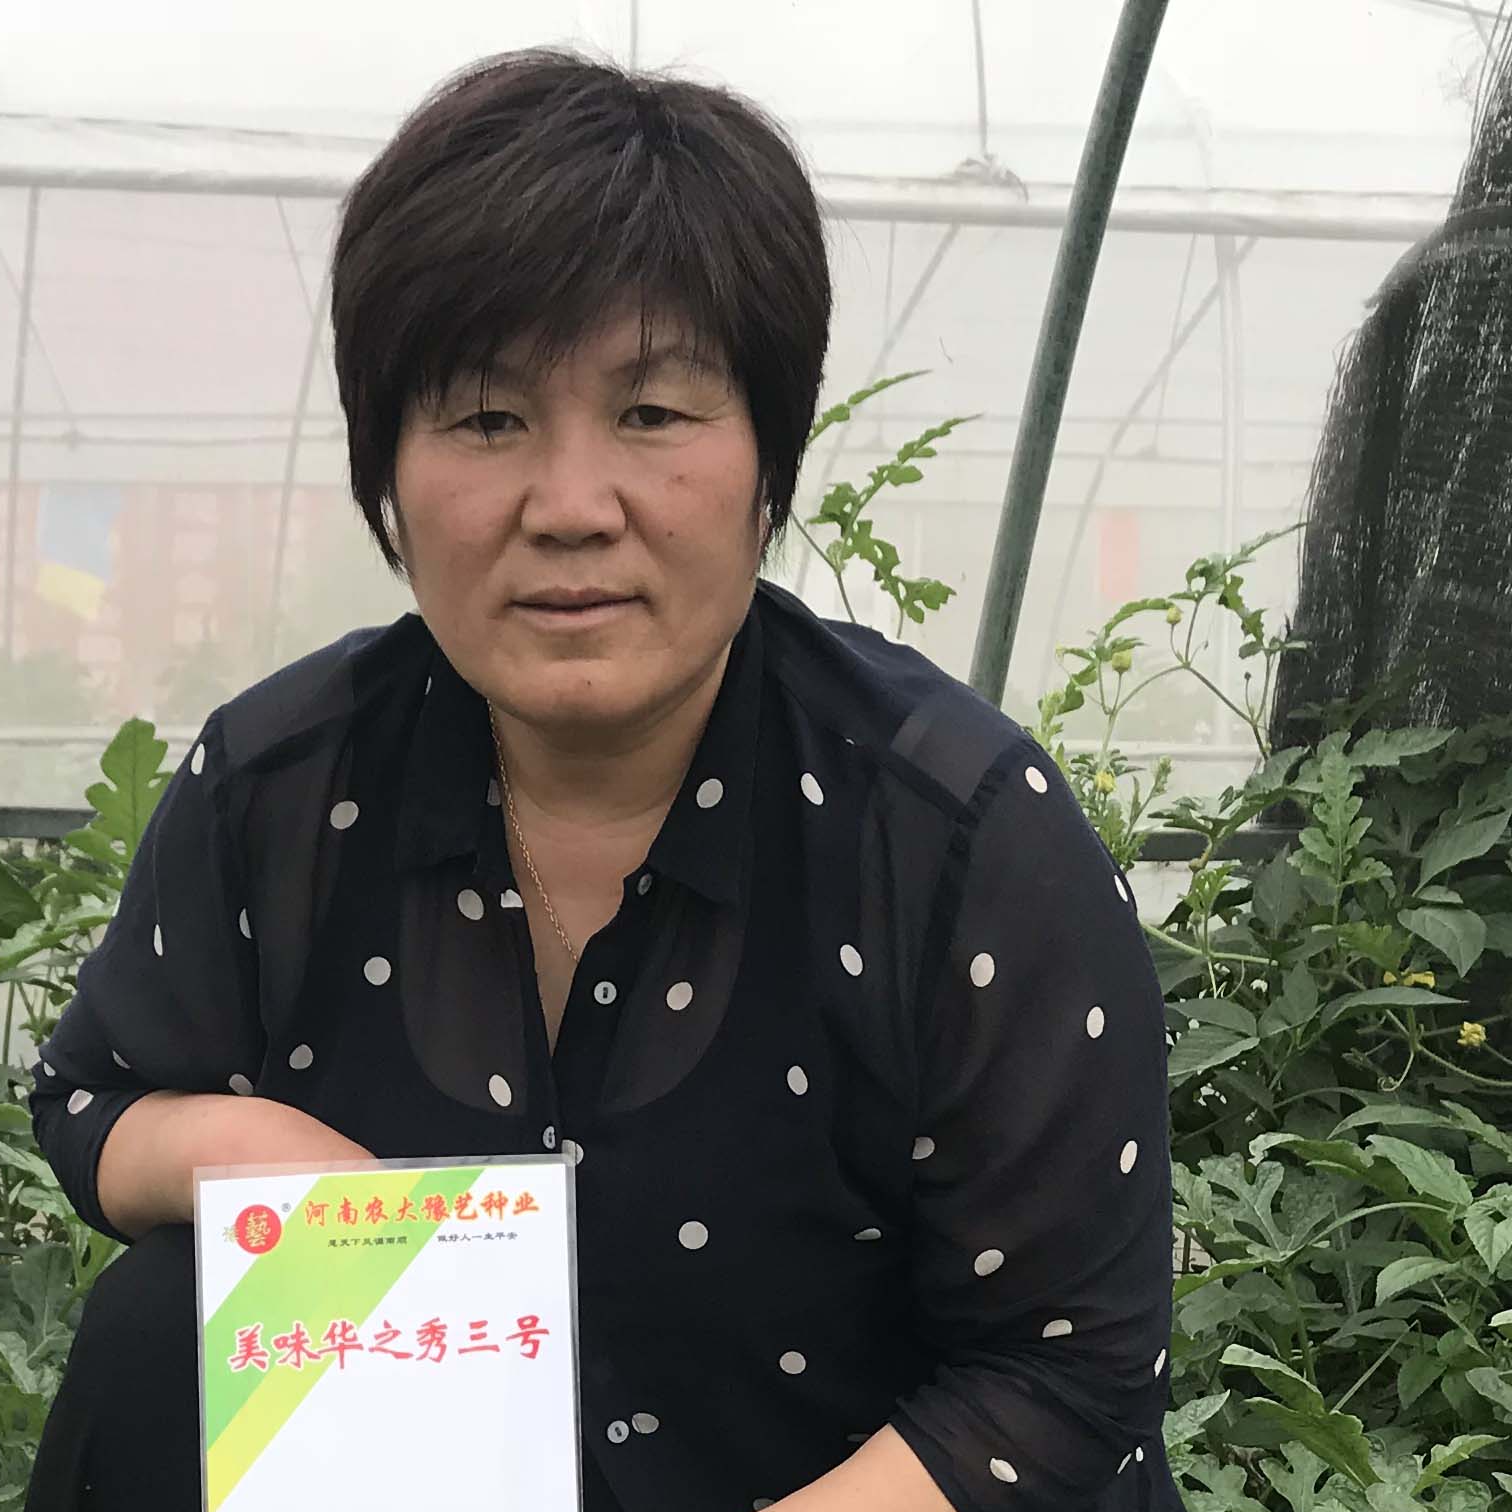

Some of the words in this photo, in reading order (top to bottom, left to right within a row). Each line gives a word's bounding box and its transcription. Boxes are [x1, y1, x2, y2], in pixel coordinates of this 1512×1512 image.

[305, 1192, 540, 1227] 河南农大豫艺种业
[230, 1315, 550, 1370] 美味华之秀三号
